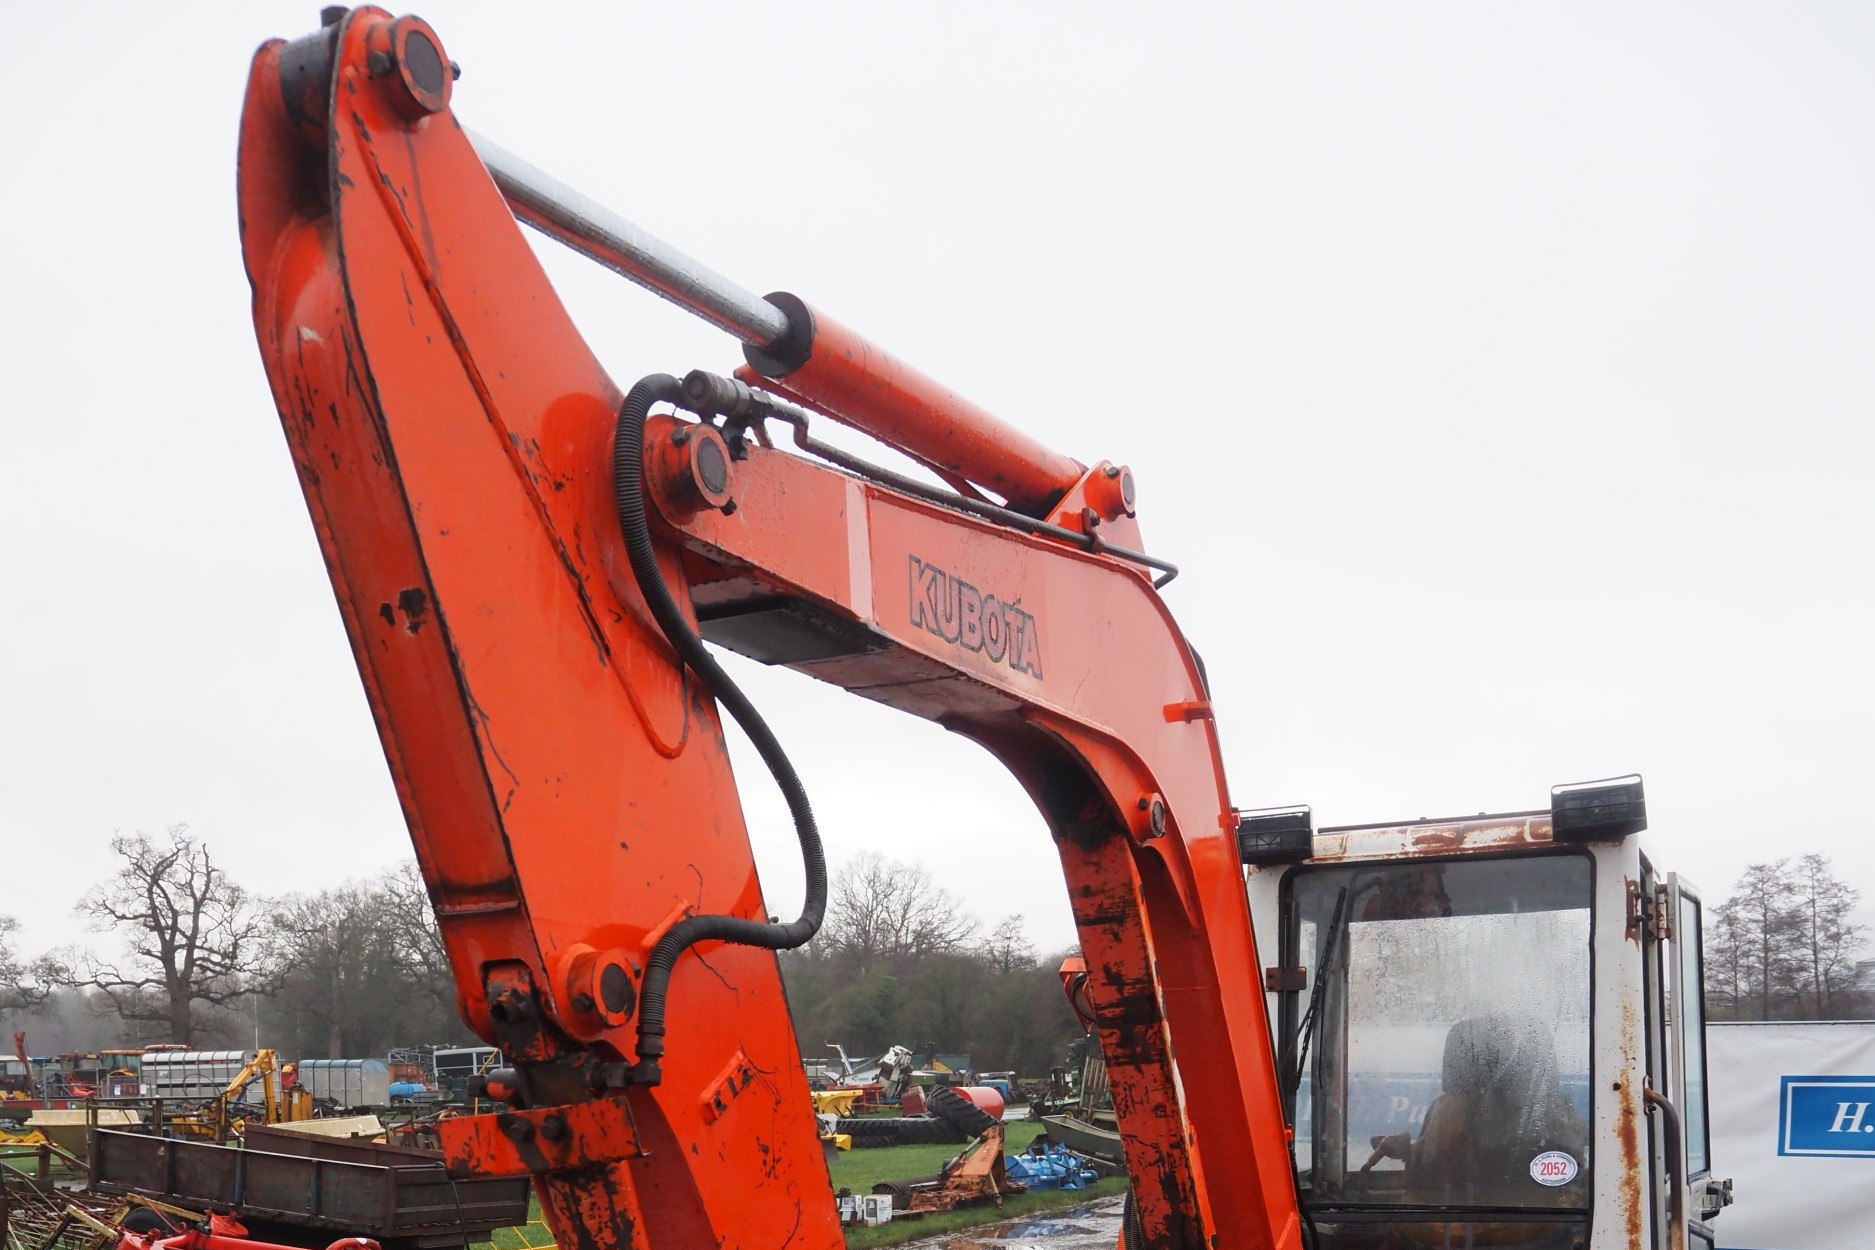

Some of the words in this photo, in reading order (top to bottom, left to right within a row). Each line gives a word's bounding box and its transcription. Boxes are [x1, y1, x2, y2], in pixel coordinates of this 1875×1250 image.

[909, 553, 1043, 681] KUBOTA
[1827, 1102, 1874, 1133] H.
[1540, 1162, 1567, 1176] 2052
